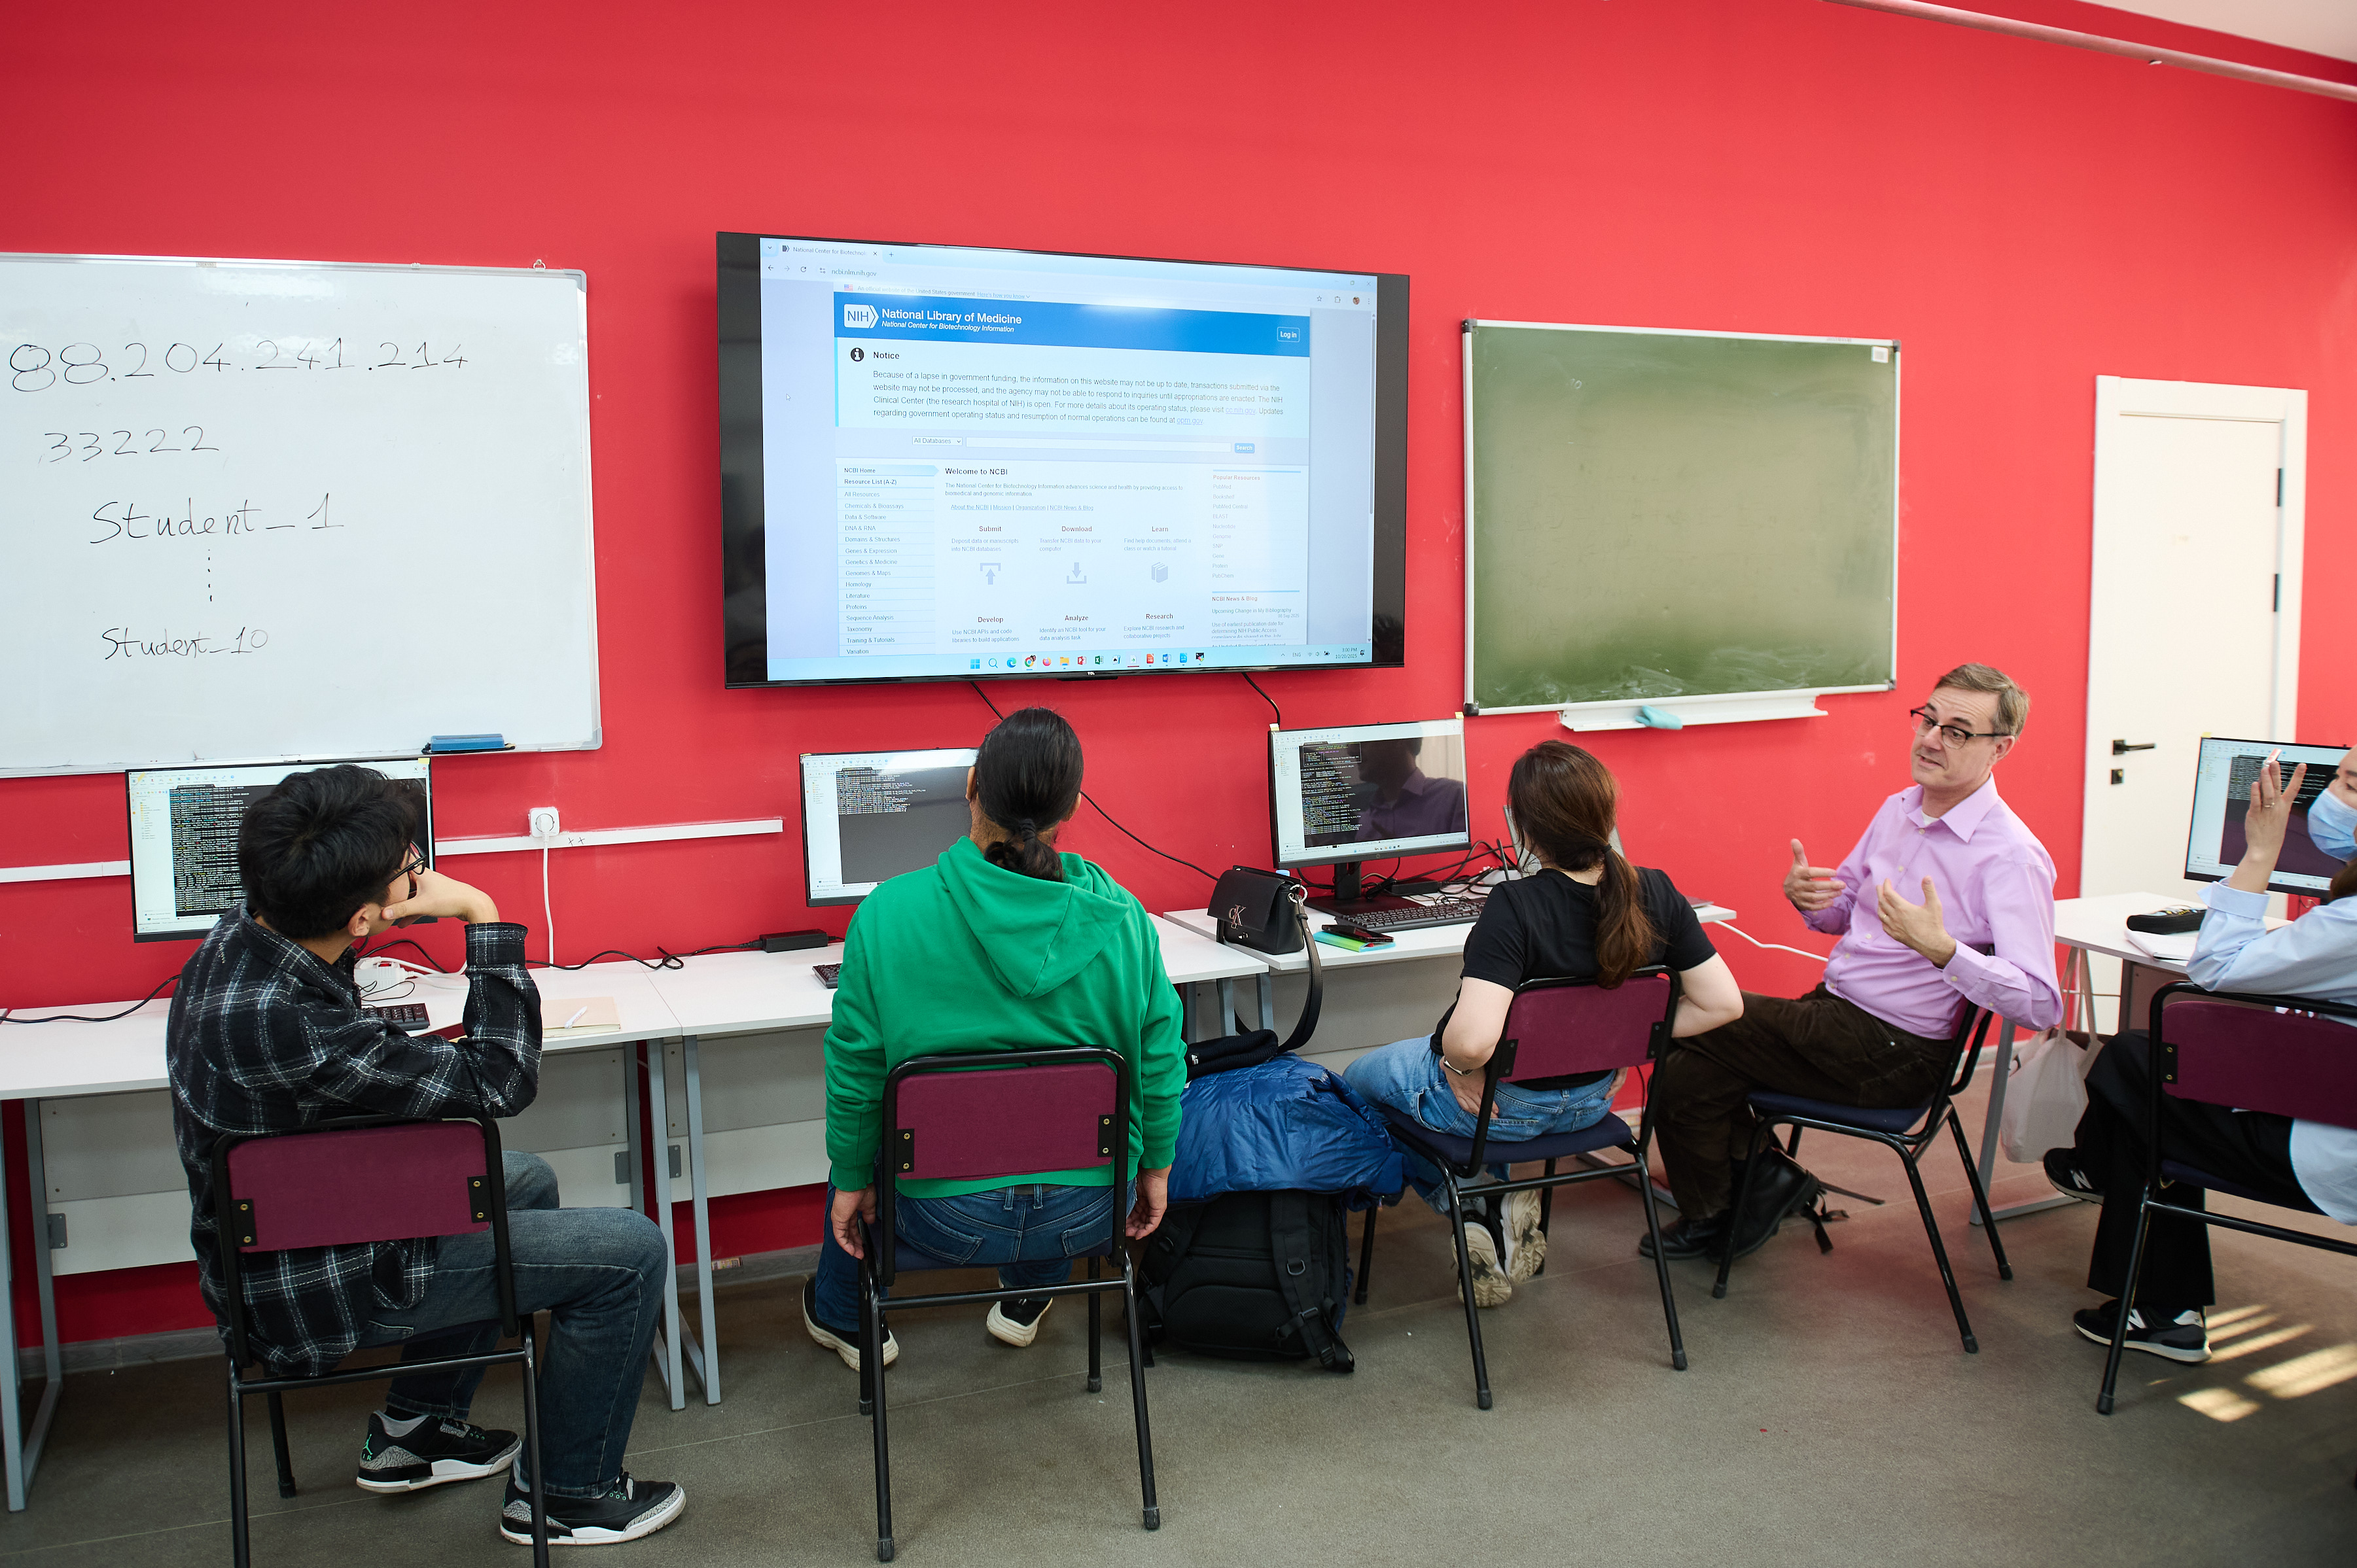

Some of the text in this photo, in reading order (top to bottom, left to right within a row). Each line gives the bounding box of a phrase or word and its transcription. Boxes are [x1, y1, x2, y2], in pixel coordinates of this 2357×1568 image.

[831, 268, 877, 278] ncbi.nlm.nih.gov
[847, 310, 869, 322] NIH
[881, 307, 1022, 324] National Library of Medicine
[938, 320, 981, 332] Biotechnology
[981, 324, 1014, 332] Information
[1280, 330, 1291, 339] Log
[873, 351, 900, 360] Notice
[9, 337, 469, 392] 88.204.241.214
[873, 370, 904, 379] Because
[920, 372, 940, 381] lapse
[949, 374, 989, 383] government
[991, 374, 1018, 384] funding,
[1032, 375, 1069, 384] information
[1119, 379, 1133, 388] may
[942, 385, 980, 395] processed,
[1008, 388, 1033, 396] agency
[1095, 390, 1122, 399] respond
[1131, 391, 1158, 400] inquiries
[1173, 393, 1218, 402] appropriations
[873, 395, 899, 404] Clinical
[925, 397, 940, 406] (the
[973, 398, 999, 408] hospital
[1033, 401, 1052, 409] open.
[1136, 404, 1166, 413] operating
[1190, 405, 1211, 413] please
[1258, 407, 1284, 415] Updates
[873, 409, 907, 419] regarding
[908, 409, 949, 419] government
[951, 410, 984, 420] operating
[1021, 413, 1058, 421] resumption
[1091, 415, 1125, 423] operations
[43, 426, 221, 462] 33222
